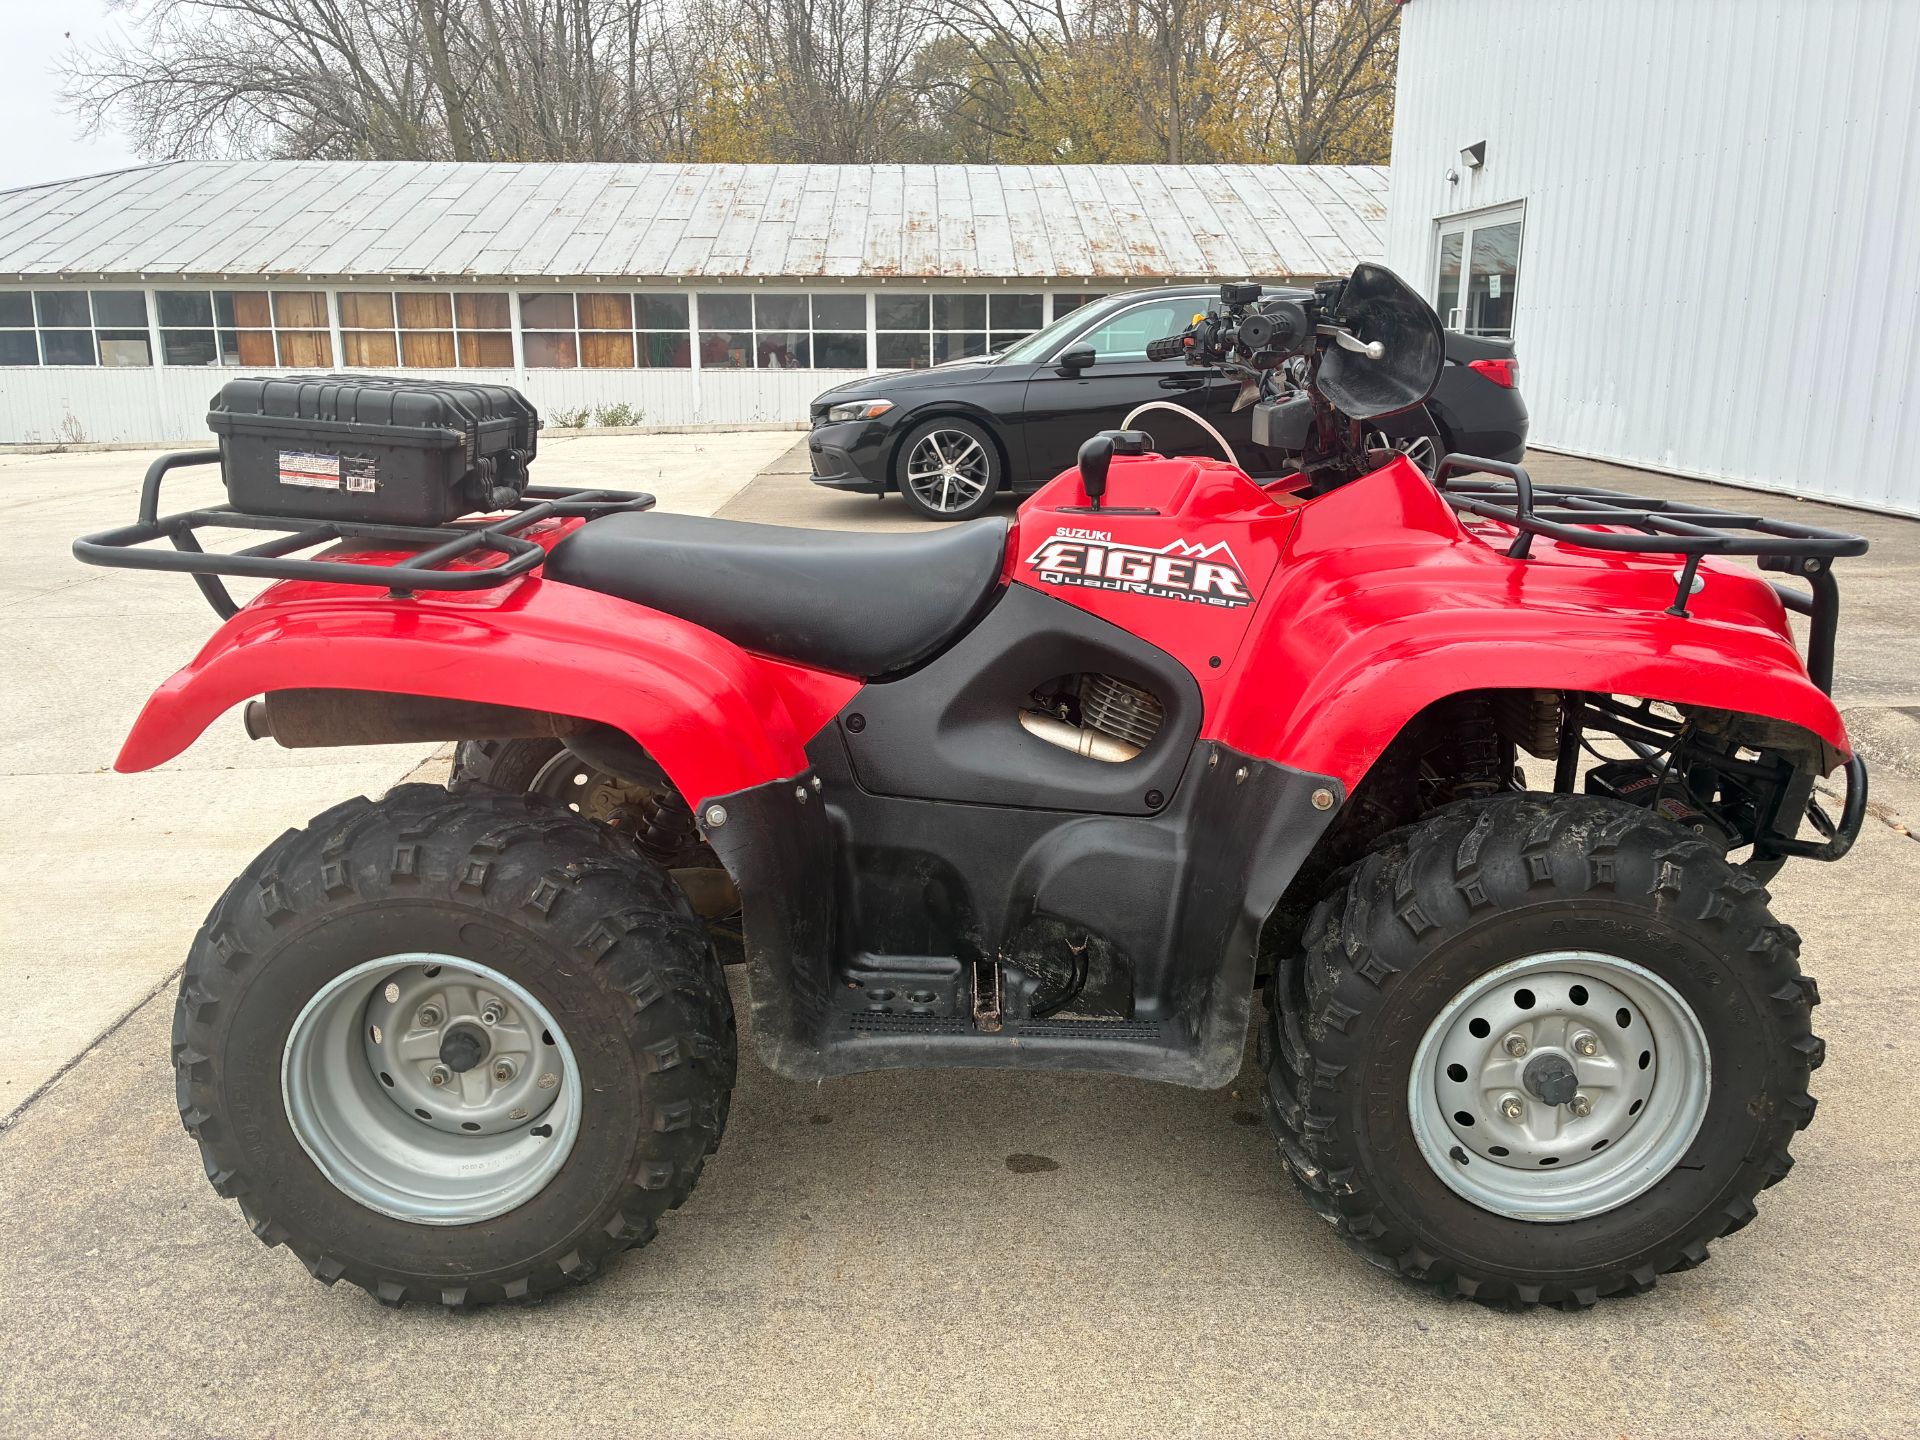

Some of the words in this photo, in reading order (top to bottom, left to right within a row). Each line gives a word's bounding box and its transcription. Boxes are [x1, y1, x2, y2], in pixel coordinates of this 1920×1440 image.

[1055, 527, 1112, 542] SUZUKI
[1037, 542, 1251, 600] EIGER
[1040, 571, 1248, 608] QuadRunner
